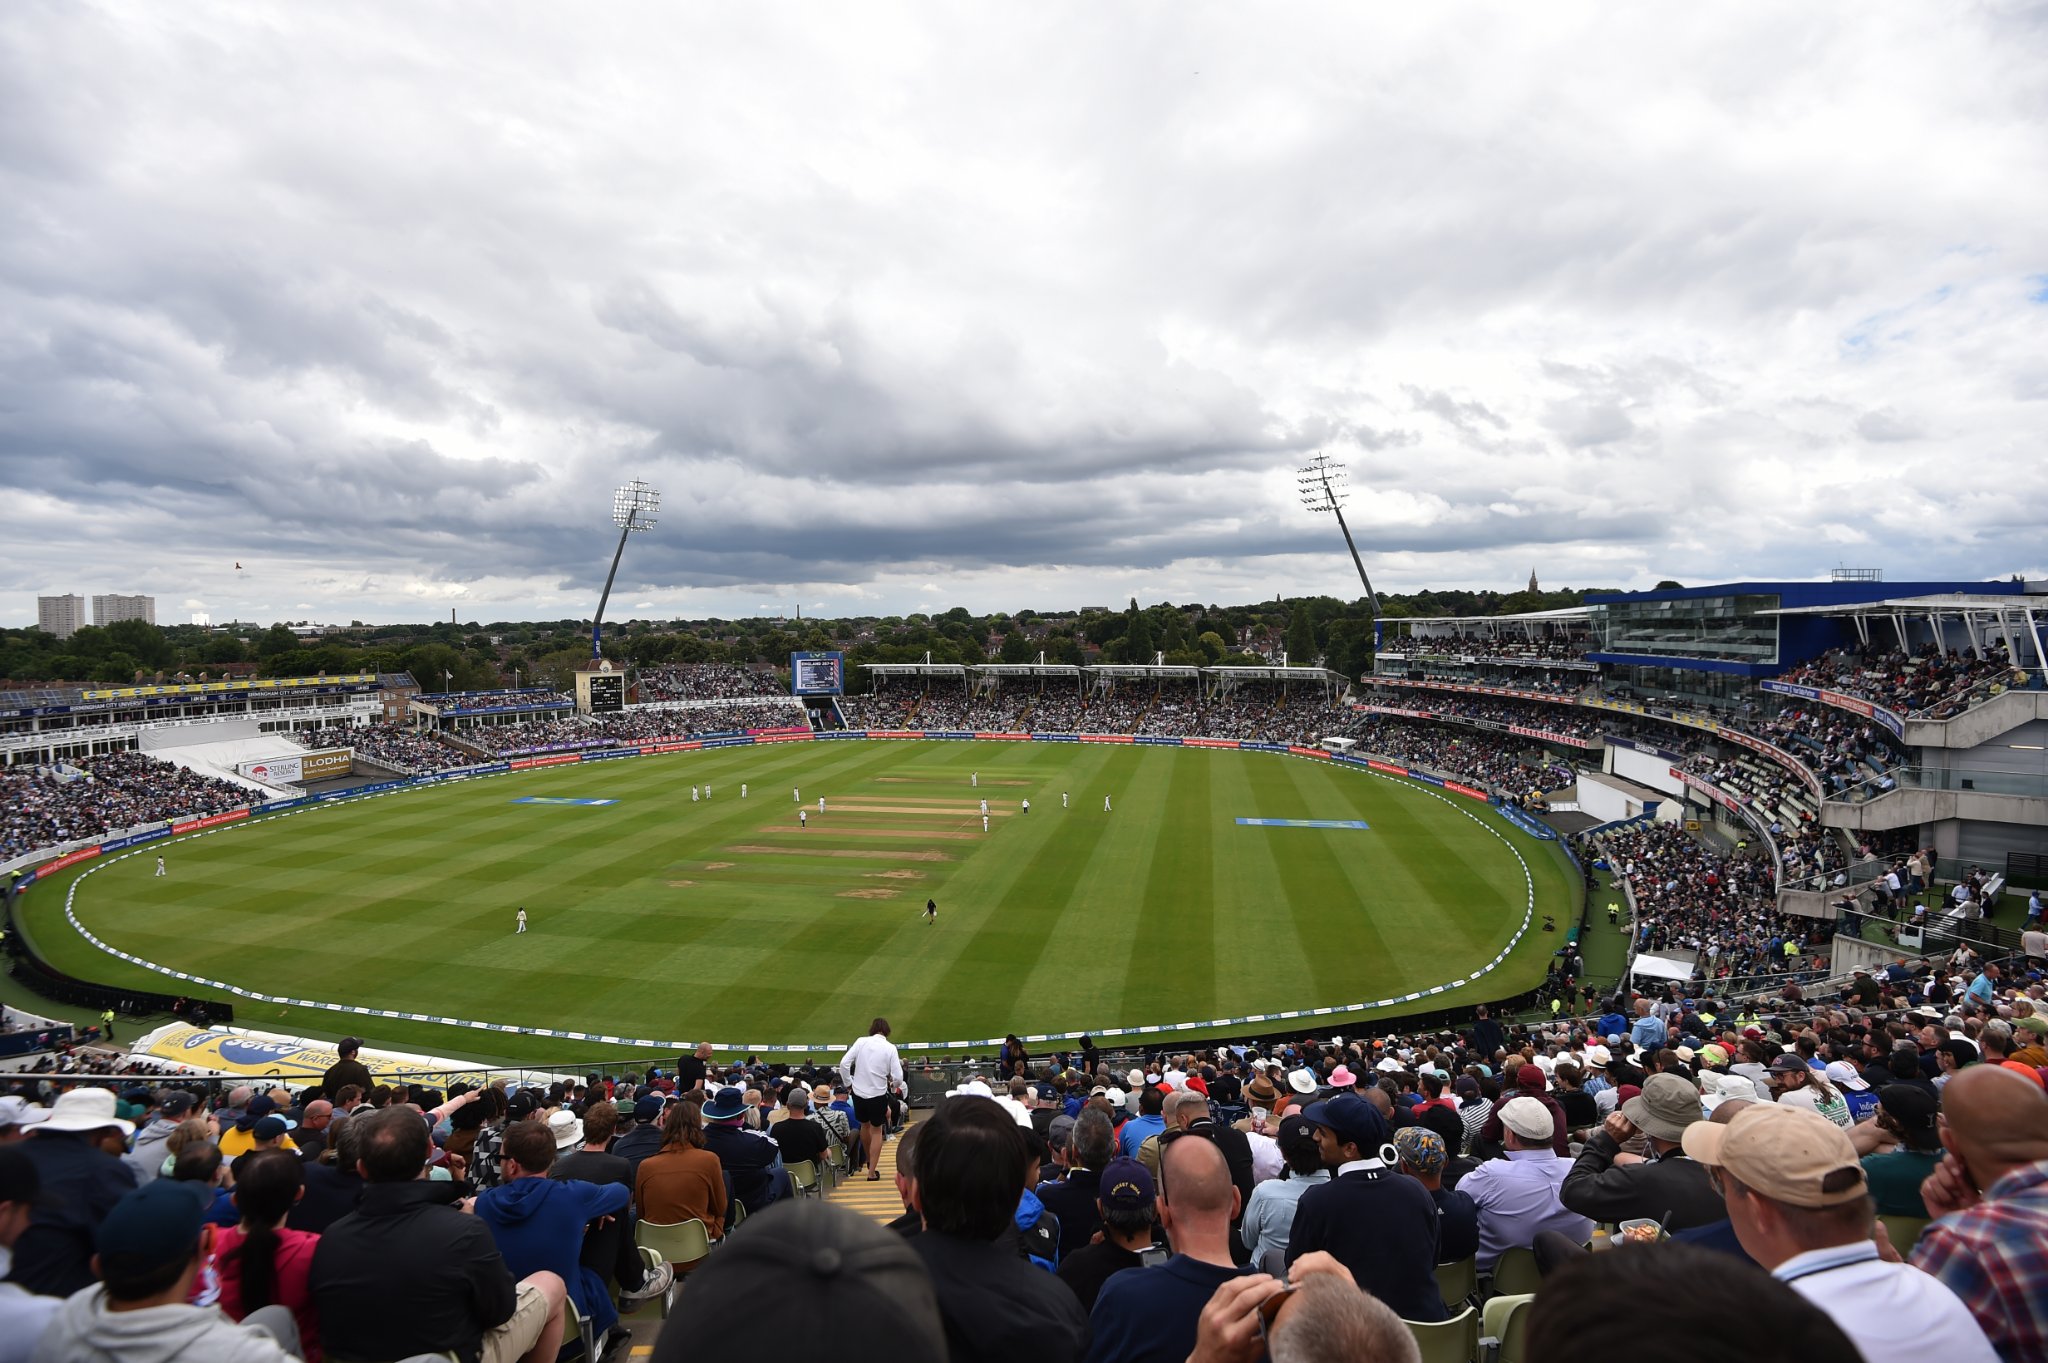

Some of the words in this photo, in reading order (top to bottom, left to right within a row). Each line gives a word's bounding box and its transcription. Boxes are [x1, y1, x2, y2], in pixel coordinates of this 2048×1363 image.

[70, 703, 105, 711] BIRMINGHAM
[1634, 742, 1658, 755] EDGBASTON
[310, 754, 349, 767] LODHA
[269, 763, 299, 772] STERLING
